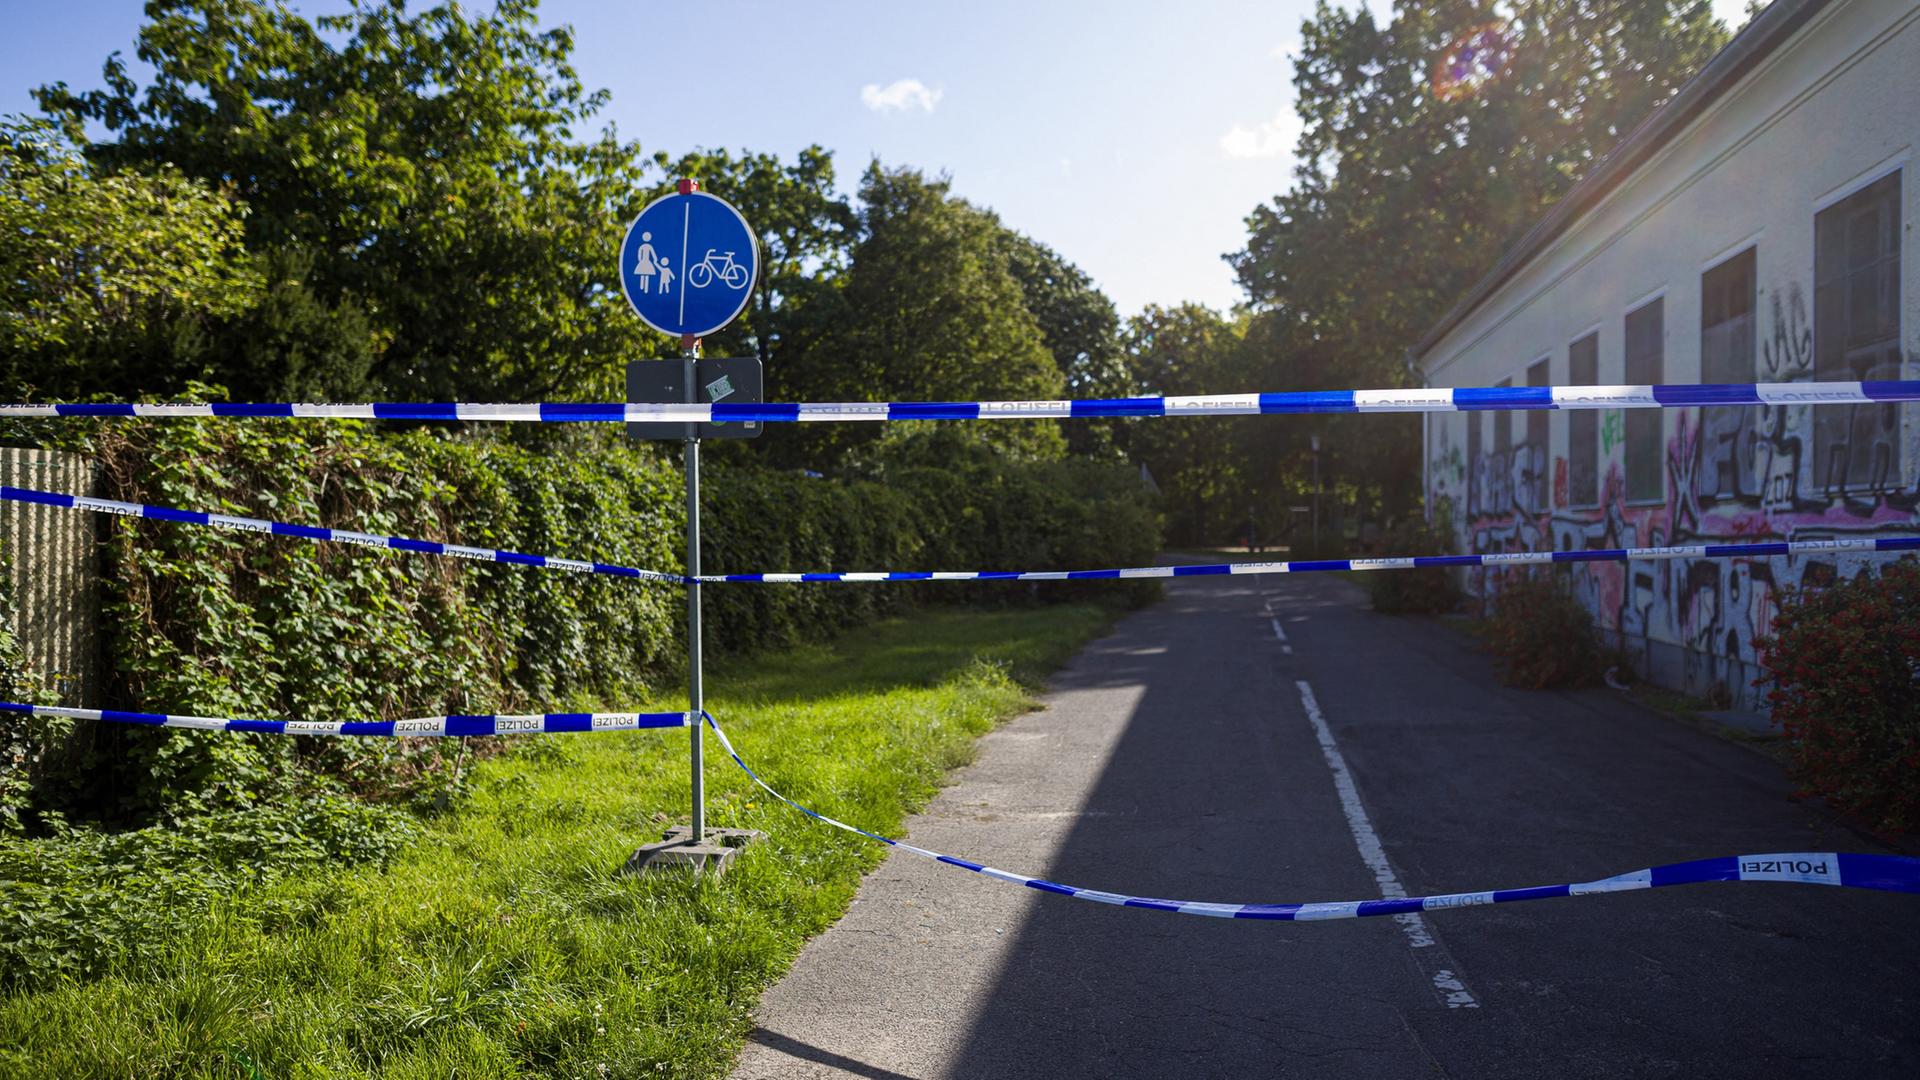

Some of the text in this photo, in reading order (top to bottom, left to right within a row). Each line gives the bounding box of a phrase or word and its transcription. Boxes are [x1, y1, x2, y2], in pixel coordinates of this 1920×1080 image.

[395, 721, 440, 732] POLIZEI
[496, 719, 539, 731] POLIZEI
[593, 716, 634, 727] POLIZEI
[1742, 860, 1828, 876] POLIZEI
